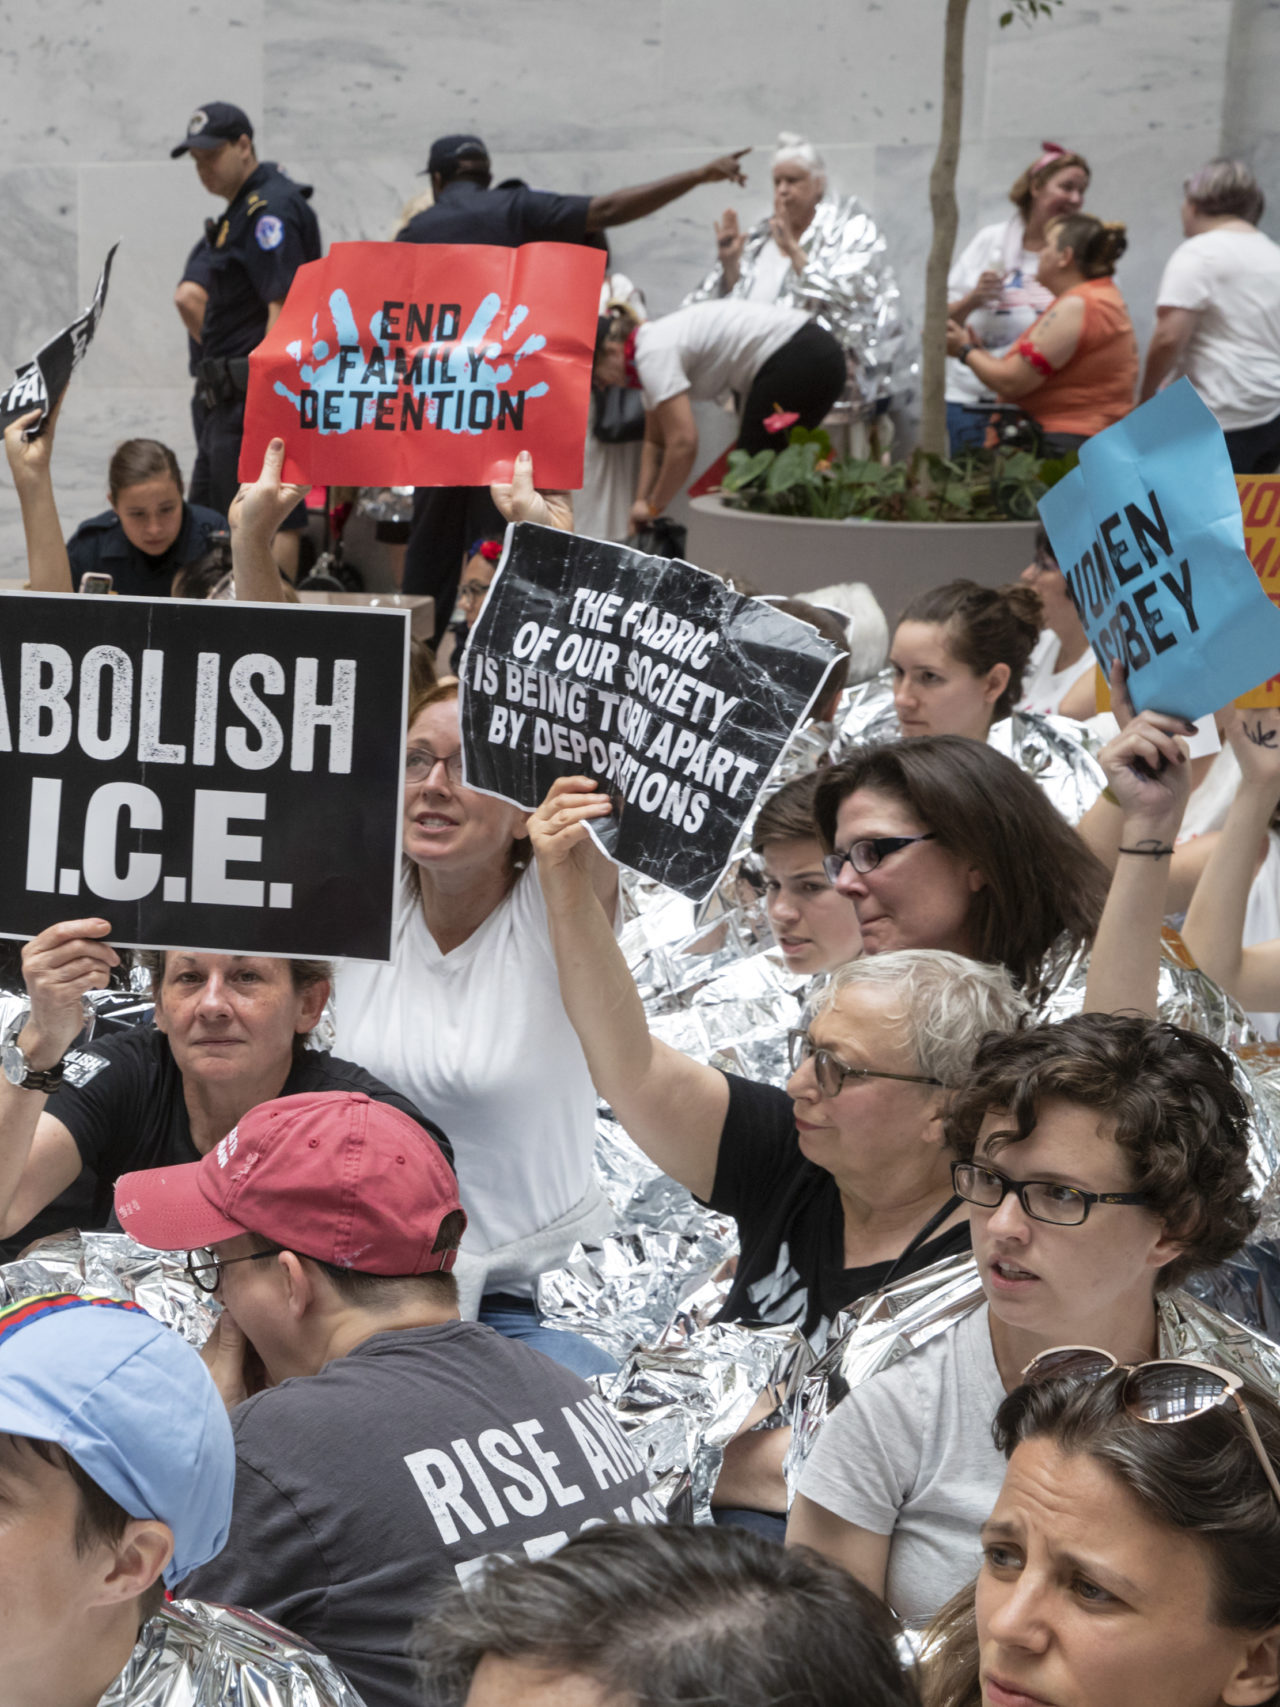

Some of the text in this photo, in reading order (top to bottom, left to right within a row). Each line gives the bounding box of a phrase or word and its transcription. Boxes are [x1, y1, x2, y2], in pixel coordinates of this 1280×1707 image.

[337, 344, 494, 385] FAMILY
[379, 300, 462, 342] END
[299, 389, 525, 431] DETENTION
[512, 620, 740, 733] OF OUR SOCIETY
[568, 587, 719, 670] THE FABRIC
[473, 653, 499, 696] IS
[505, 662, 587, 724] BEING
[646, 720, 759, 799] APART
[488, 705, 710, 834] BY DEPORTIONS
[25, 776, 293, 909] I.C.E.
[403, 1418, 585, 1545] RISE
